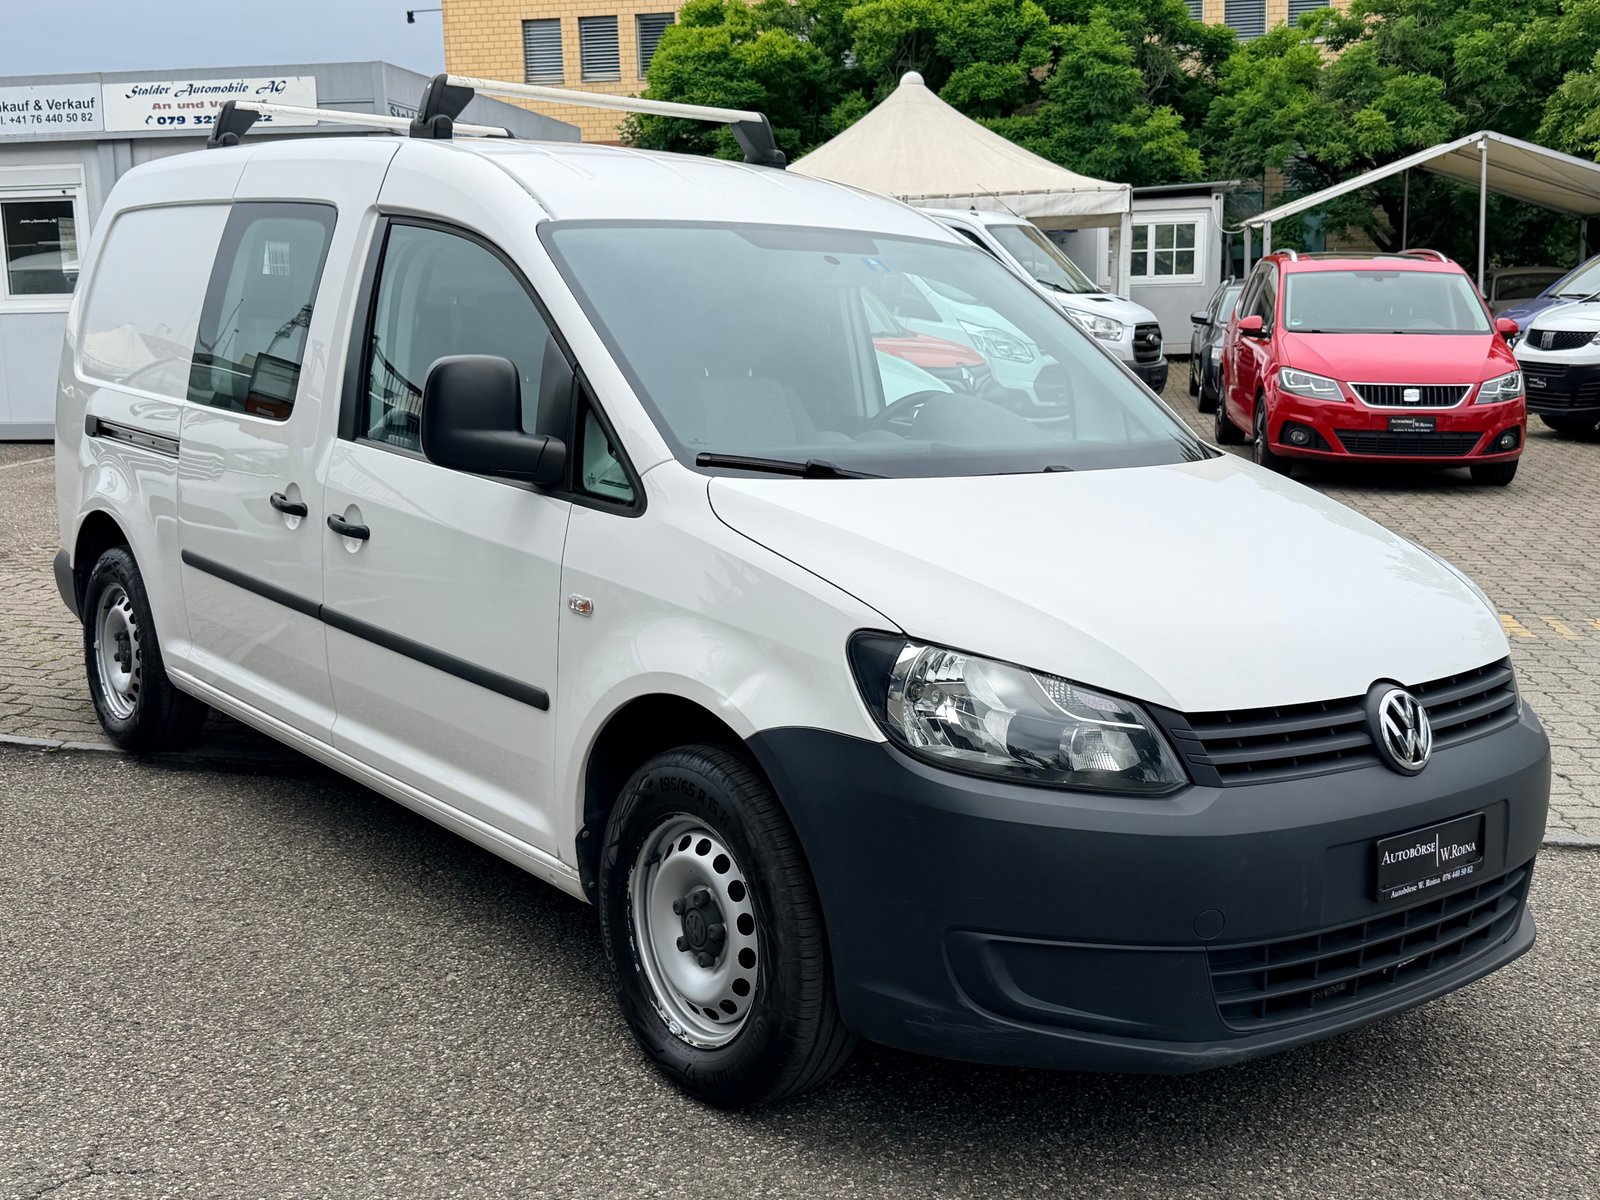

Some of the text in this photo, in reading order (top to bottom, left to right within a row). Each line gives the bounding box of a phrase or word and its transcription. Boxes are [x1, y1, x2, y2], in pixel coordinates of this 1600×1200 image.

[125, 80, 287, 99] Stalder Automobile AG
[0, 97, 95, 113] kauf & Verkauf
[177, 101, 204, 109] und
[9, 115, 26, 124] +41
[30, 114, 43, 124] 76
[45, 113, 63, 123] 440
[66, 112, 78, 122] 50
[81, 112, 93, 122] 82
[157, 116, 186, 125] 079
[659, 777, 695, 798] 195/65
[697, 788, 706, 805] R
[707, 797, 720, 816] 15
[1381, 841, 1476, 865] AUTOBÖRSE W.ROINA
[1442, 872, 1451, 882] 076
[1452, 870, 1461, 879] 440
[1461, 867, 1467, 876] 50
[1467, 865, 1474, 874] 82
